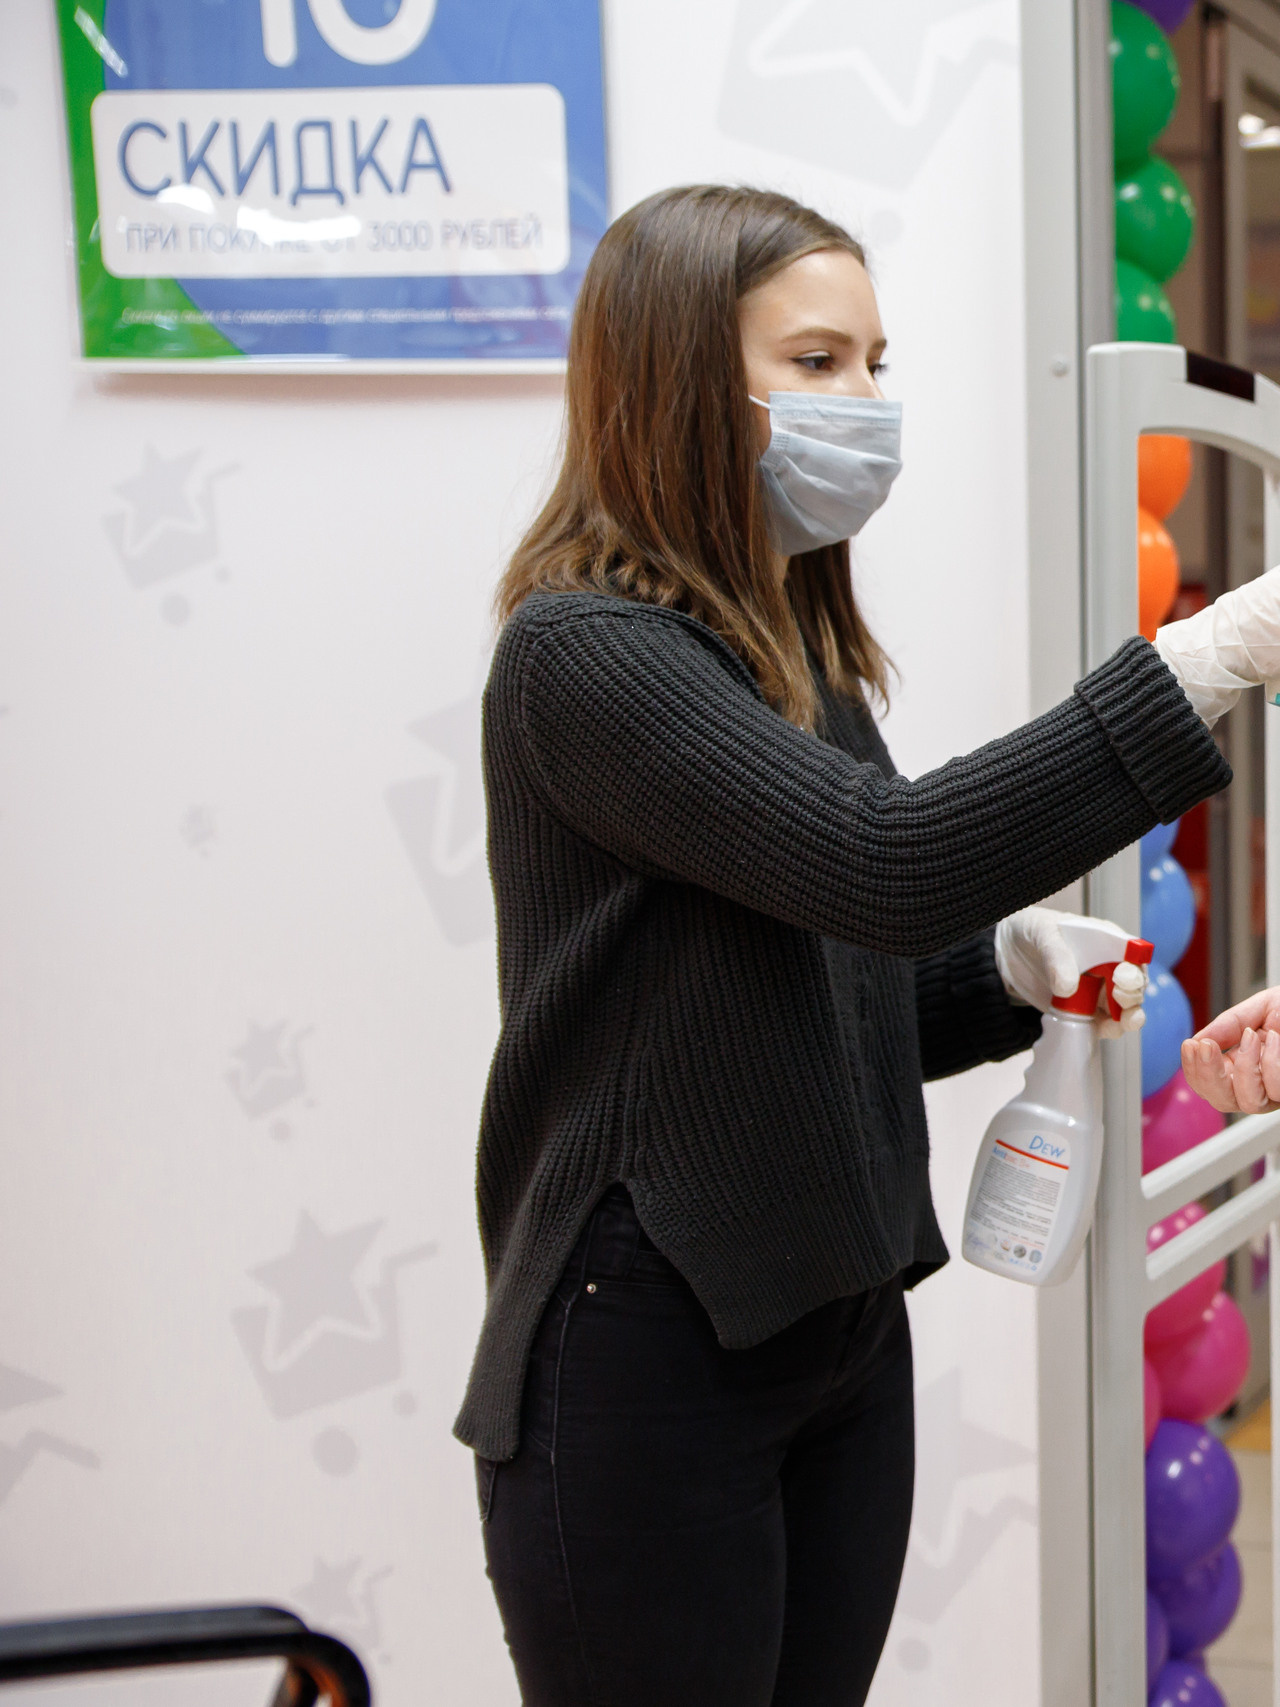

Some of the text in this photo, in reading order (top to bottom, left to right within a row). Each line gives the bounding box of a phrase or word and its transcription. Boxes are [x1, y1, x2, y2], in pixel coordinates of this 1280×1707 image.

[117, 115, 453, 207] СКИДКА
[126, 222, 177, 253] ПРИ
[368, 220, 433, 251] 3000
[440, 212, 544, 250] РУБЛЕЙ
